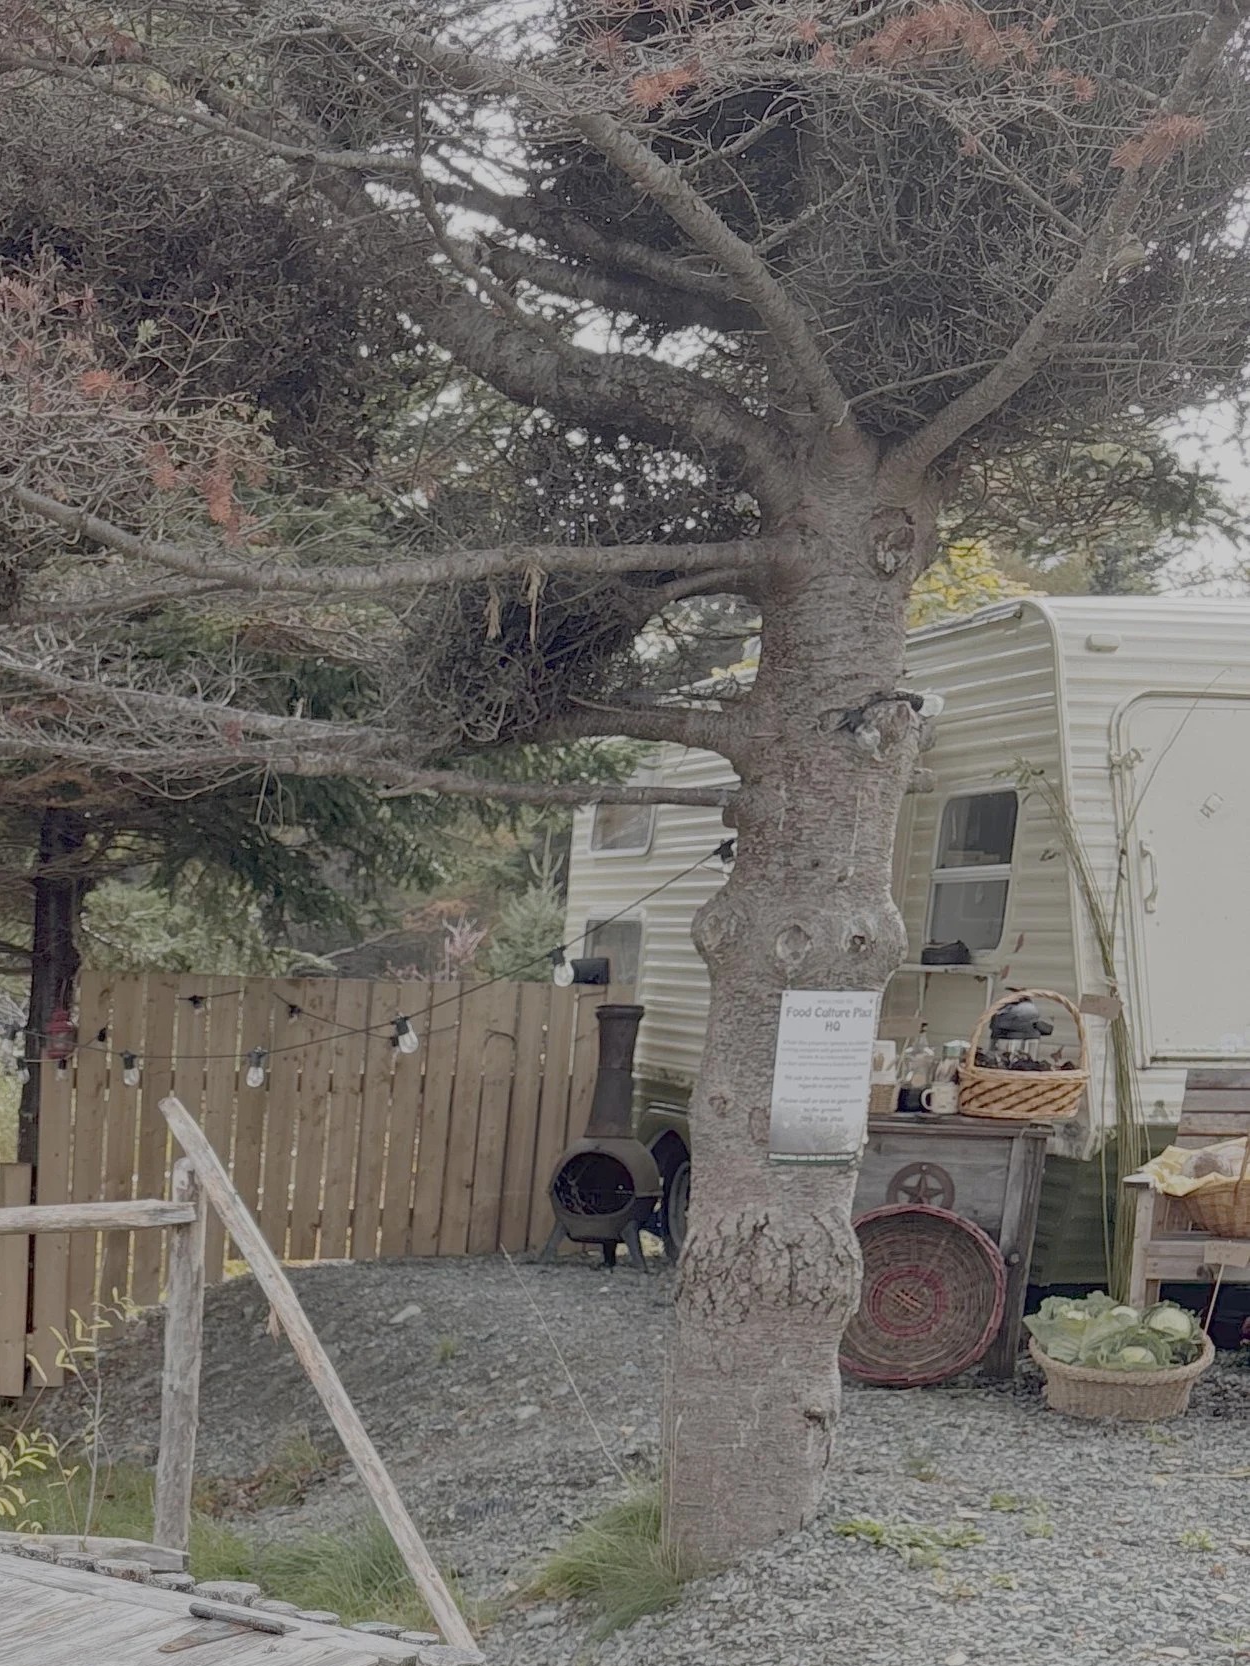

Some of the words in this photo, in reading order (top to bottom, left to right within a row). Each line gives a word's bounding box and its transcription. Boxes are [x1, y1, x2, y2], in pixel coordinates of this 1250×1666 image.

[786, 1006, 812, 1018] Food
[814, 1006, 851, 1018] Culture
[824, 1020, 841, 1032] HQ
